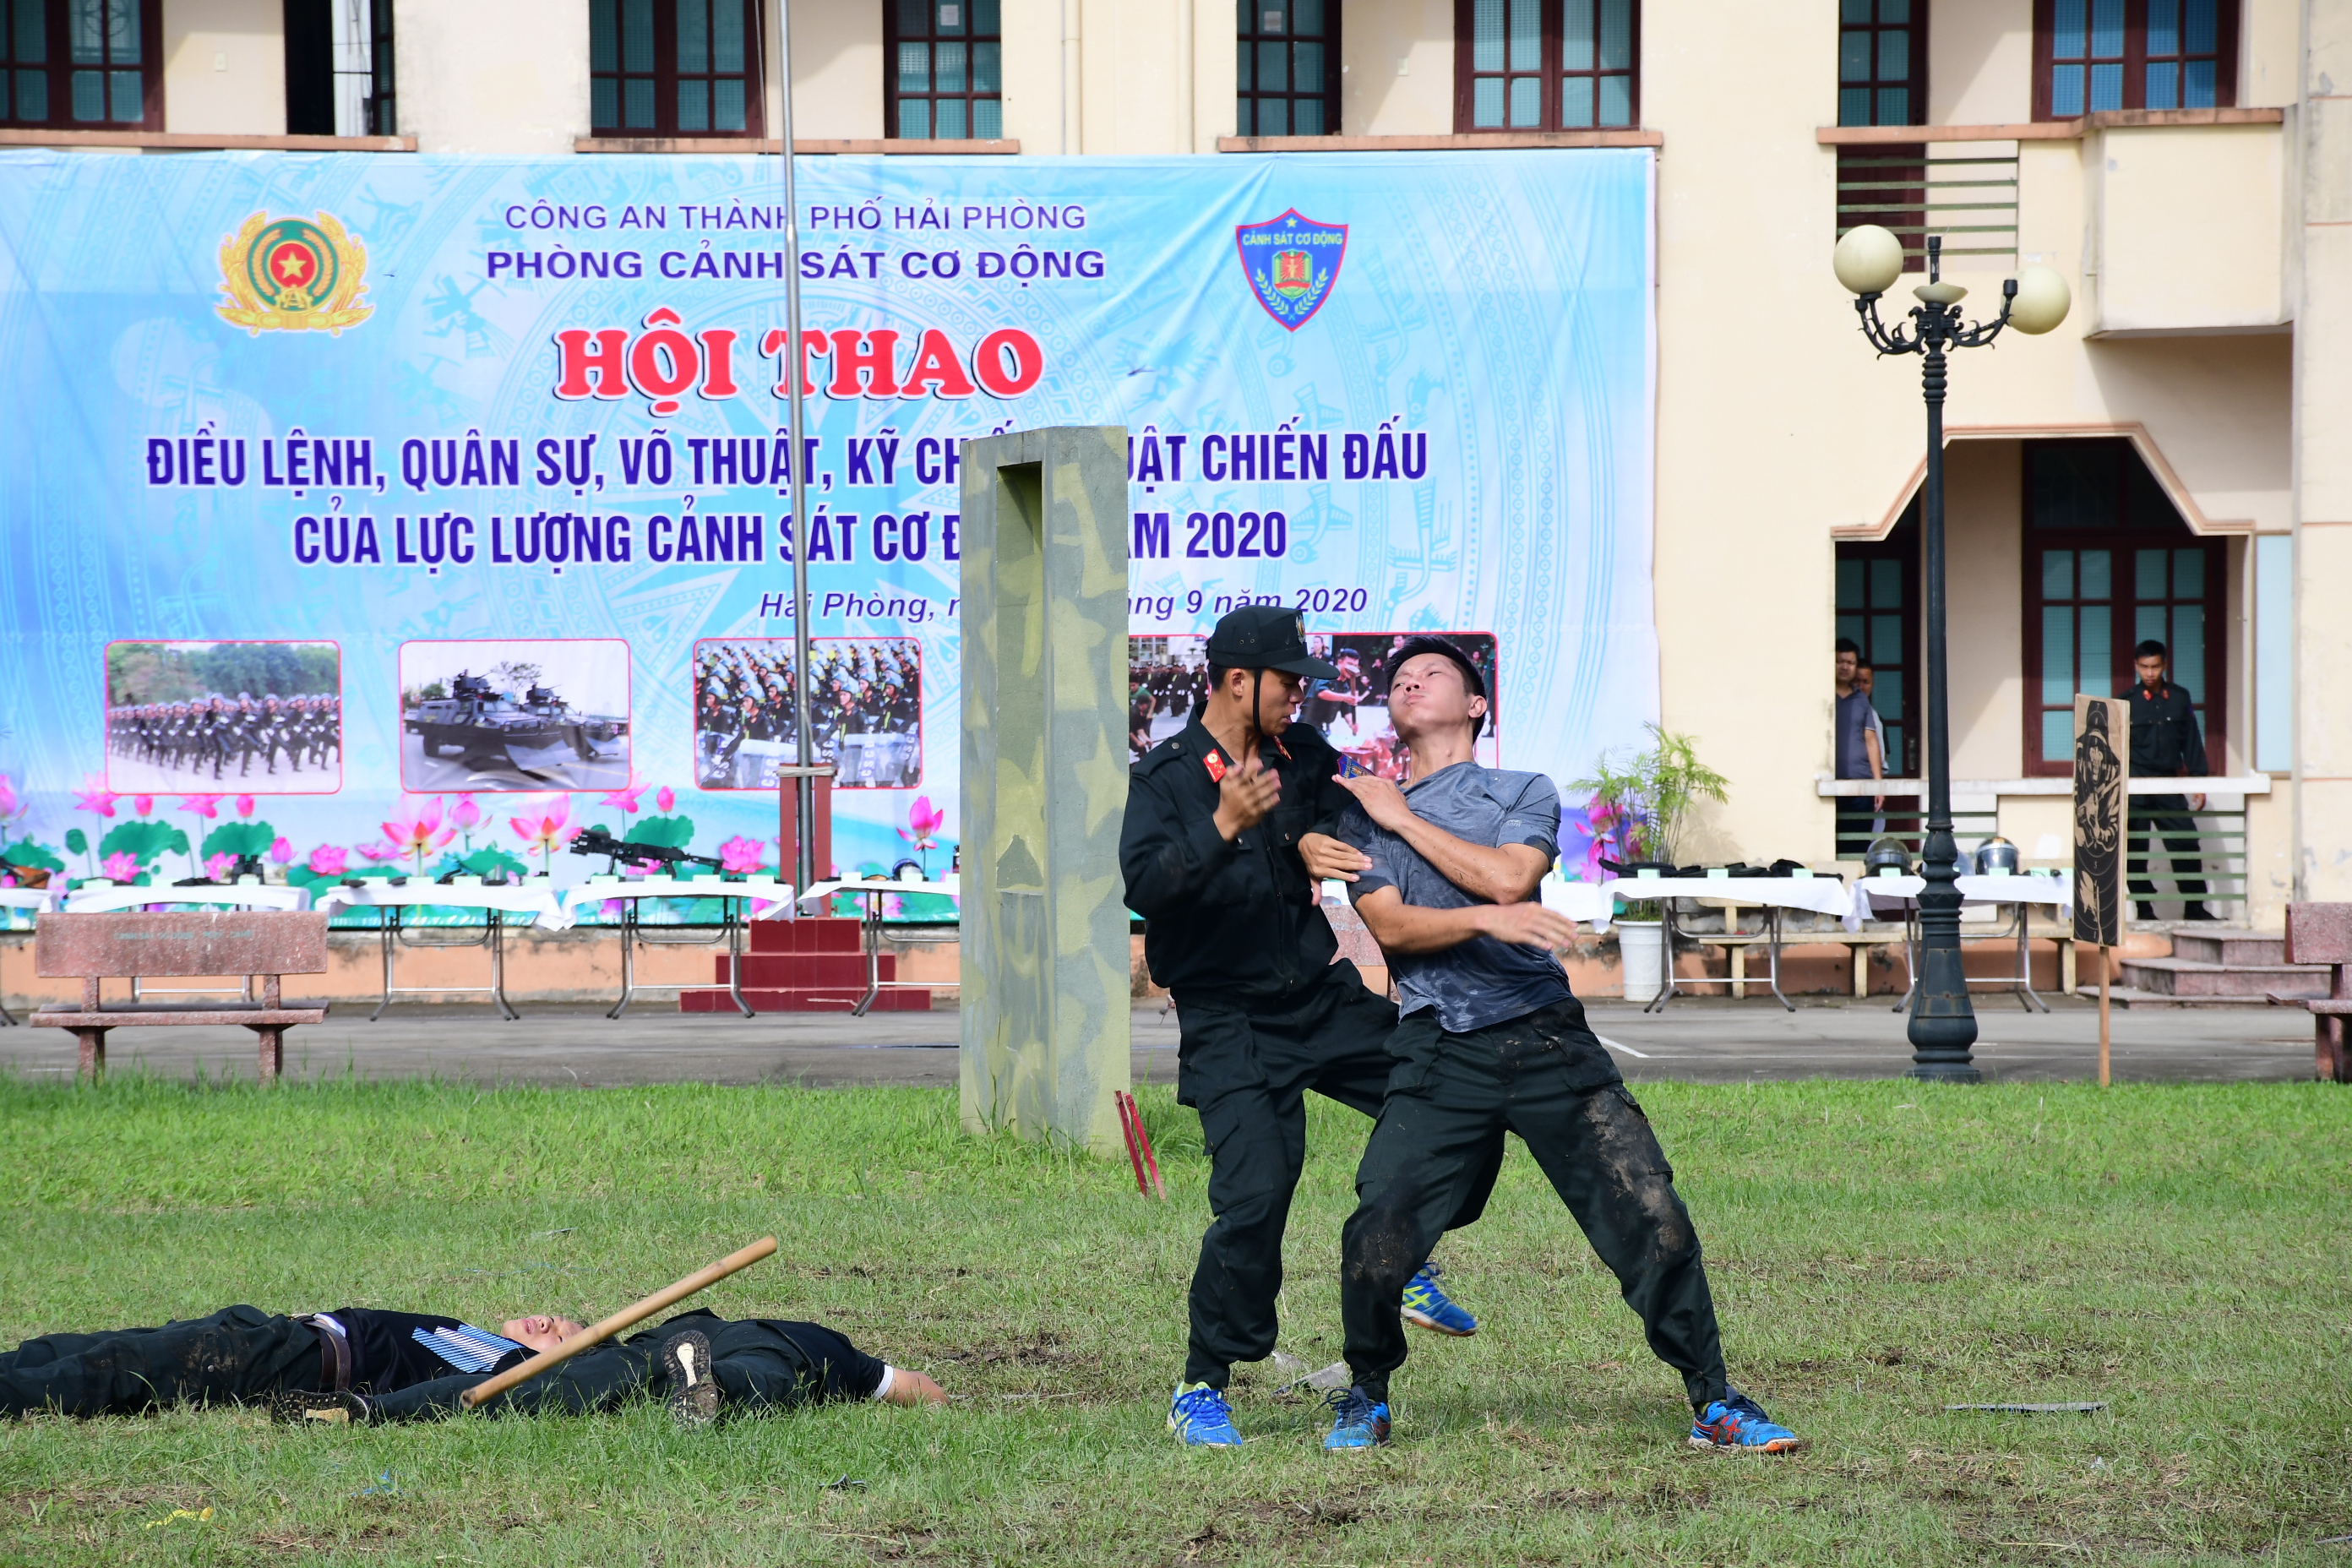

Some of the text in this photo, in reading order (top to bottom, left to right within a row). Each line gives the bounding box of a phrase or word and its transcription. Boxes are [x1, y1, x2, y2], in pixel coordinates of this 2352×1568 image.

[506, 199, 606, 229] CÔNG
[619, 206, 665, 229] AN
[811, 195, 882, 229] PHỐ
[896, 199, 949, 229] HẢI
[964, 199, 1085, 229] PHÒNG
[1243, 231, 1271, 245] CẢNH
[1274, 231, 1293, 245] SÁT
[1313, 231, 1342, 247] ĐỘNG
[487, 240, 1104, 287] PHÒNG CẢNH SÁT CƠ ĐỘNG
[558, 308, 1043, 414] HỘI THAO
[146, 422, 245, 486] ĐIỀU
[263, 429, 384, 496] LỆNH,
[403, 429, 519, 492] QUÂN
[536, 434, 603, 496] SỰ,
[619, 429, 672, 485] VÕ
[684, 428, 831, 496] THUẬT,
[848, 428, 899, 484] KỸ
[1203, 416, 1327, 482] CHIẾN
[1342, 416, 1426, 480] ĐẤU
[295, 495, 380, 564] CỦA
[396, 512, 474, 574] LỰC
[492, 511, 630, 574] LƯỢNG
[648, 495, 762, 563] CẢNH
[874, 511, 929, 561] CƠ
[1186, 512, 1286, 558] 2020
[823, 593, 934, 623] Phòng,
[1186, 590, 1203, 614] 9
[1214, 589, 1281, 614] năm
[1296, 589, 1368, 613] 2020
